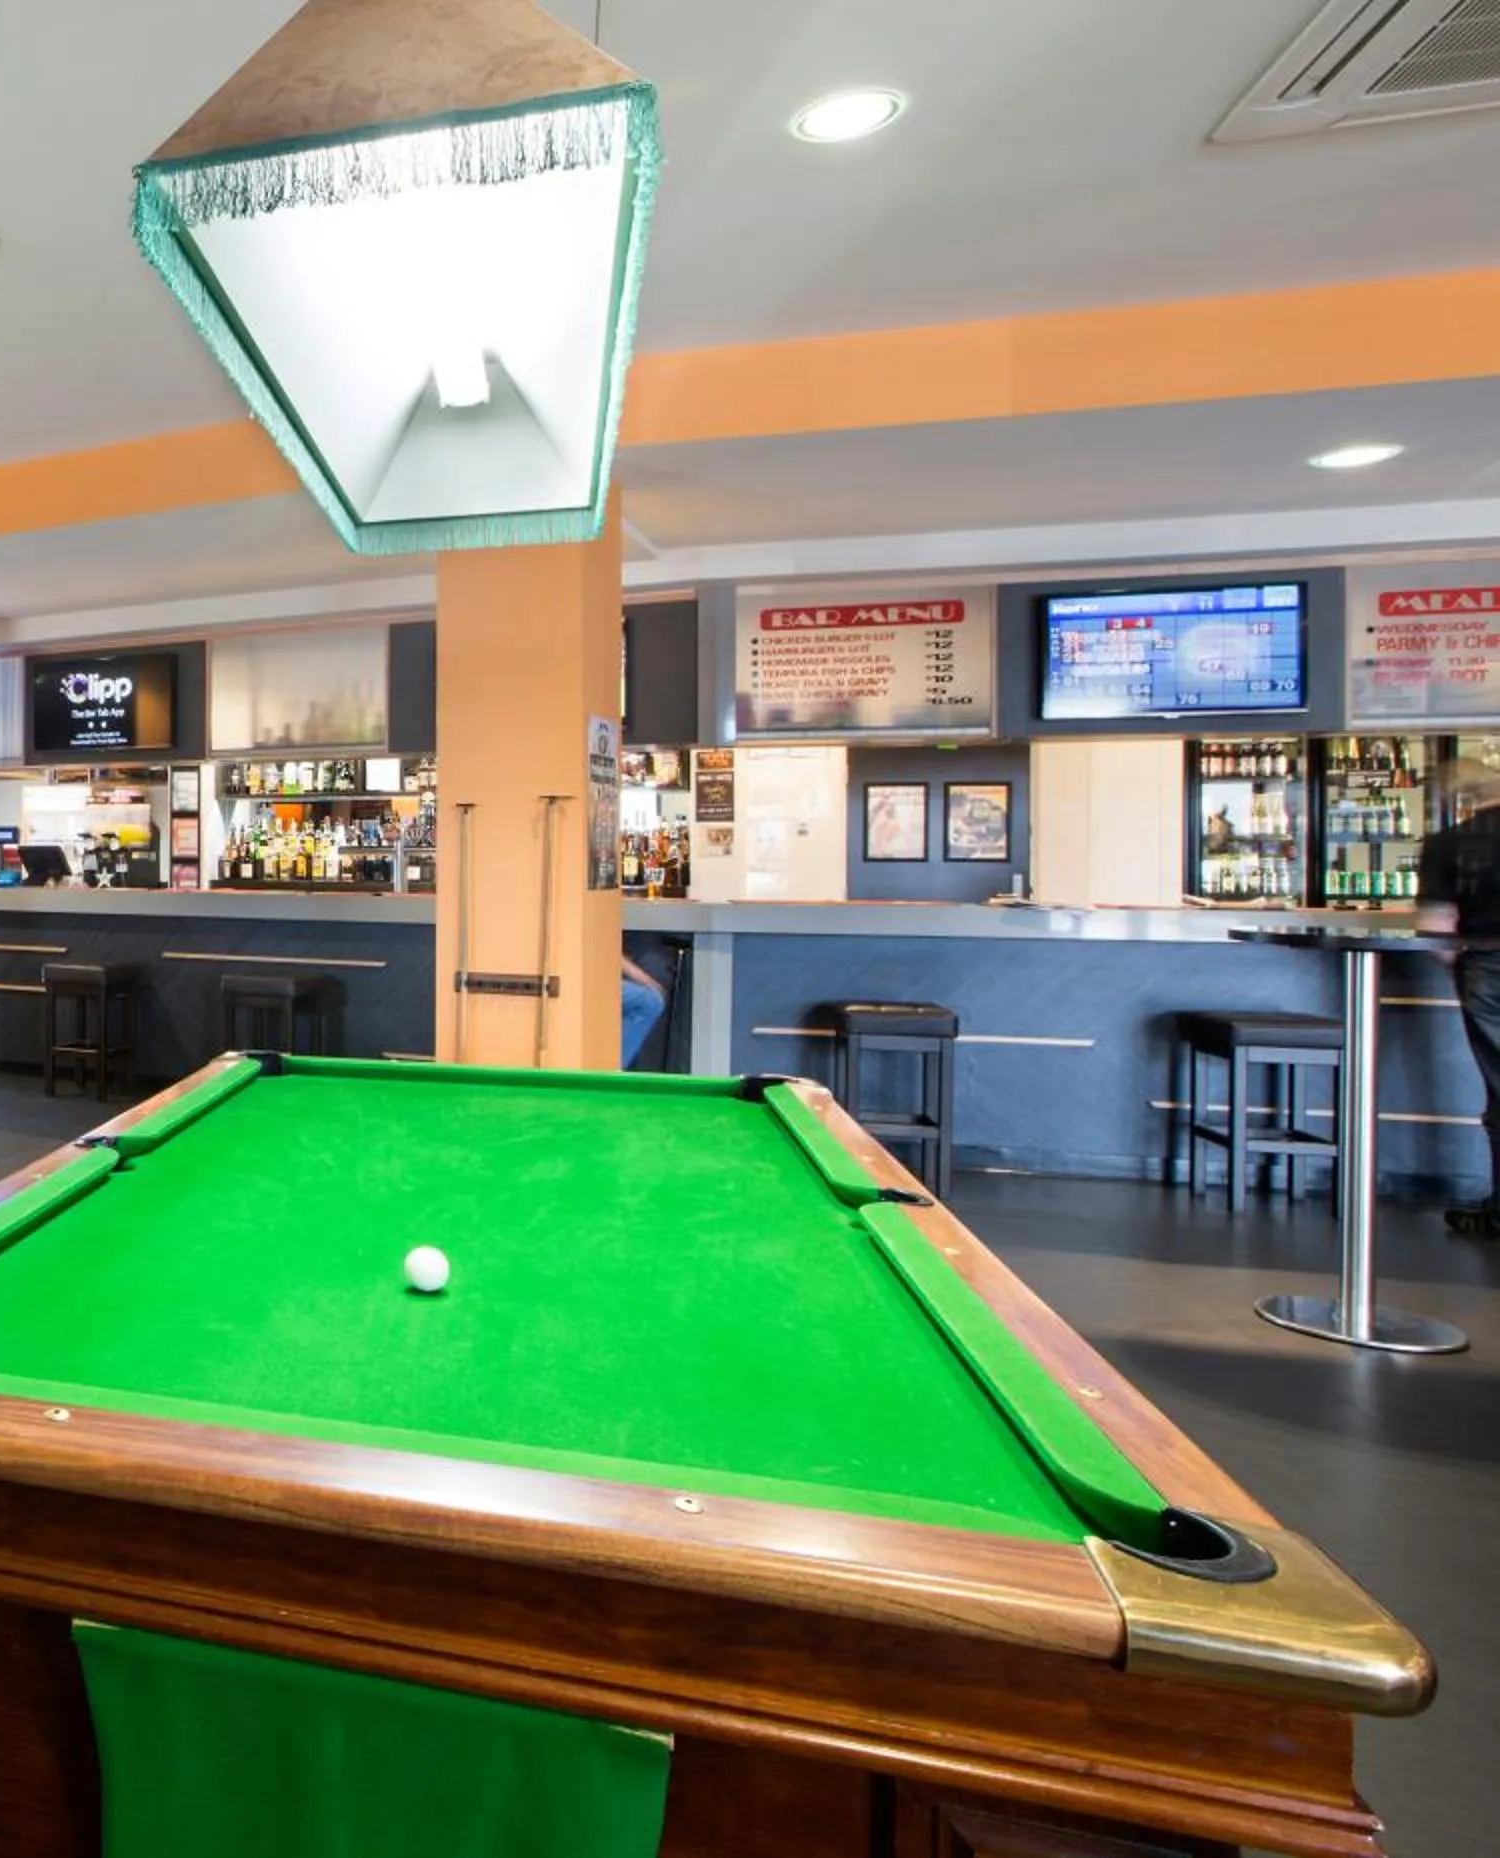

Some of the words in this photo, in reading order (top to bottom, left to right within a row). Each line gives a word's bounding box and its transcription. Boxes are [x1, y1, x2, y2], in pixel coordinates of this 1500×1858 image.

[770, 609, 842, 628] BAR
[851, 604, 956, 625] MENU
[1376, 636, 1440, 652] PARMY
[61, 673, 133, 704] Clipp
